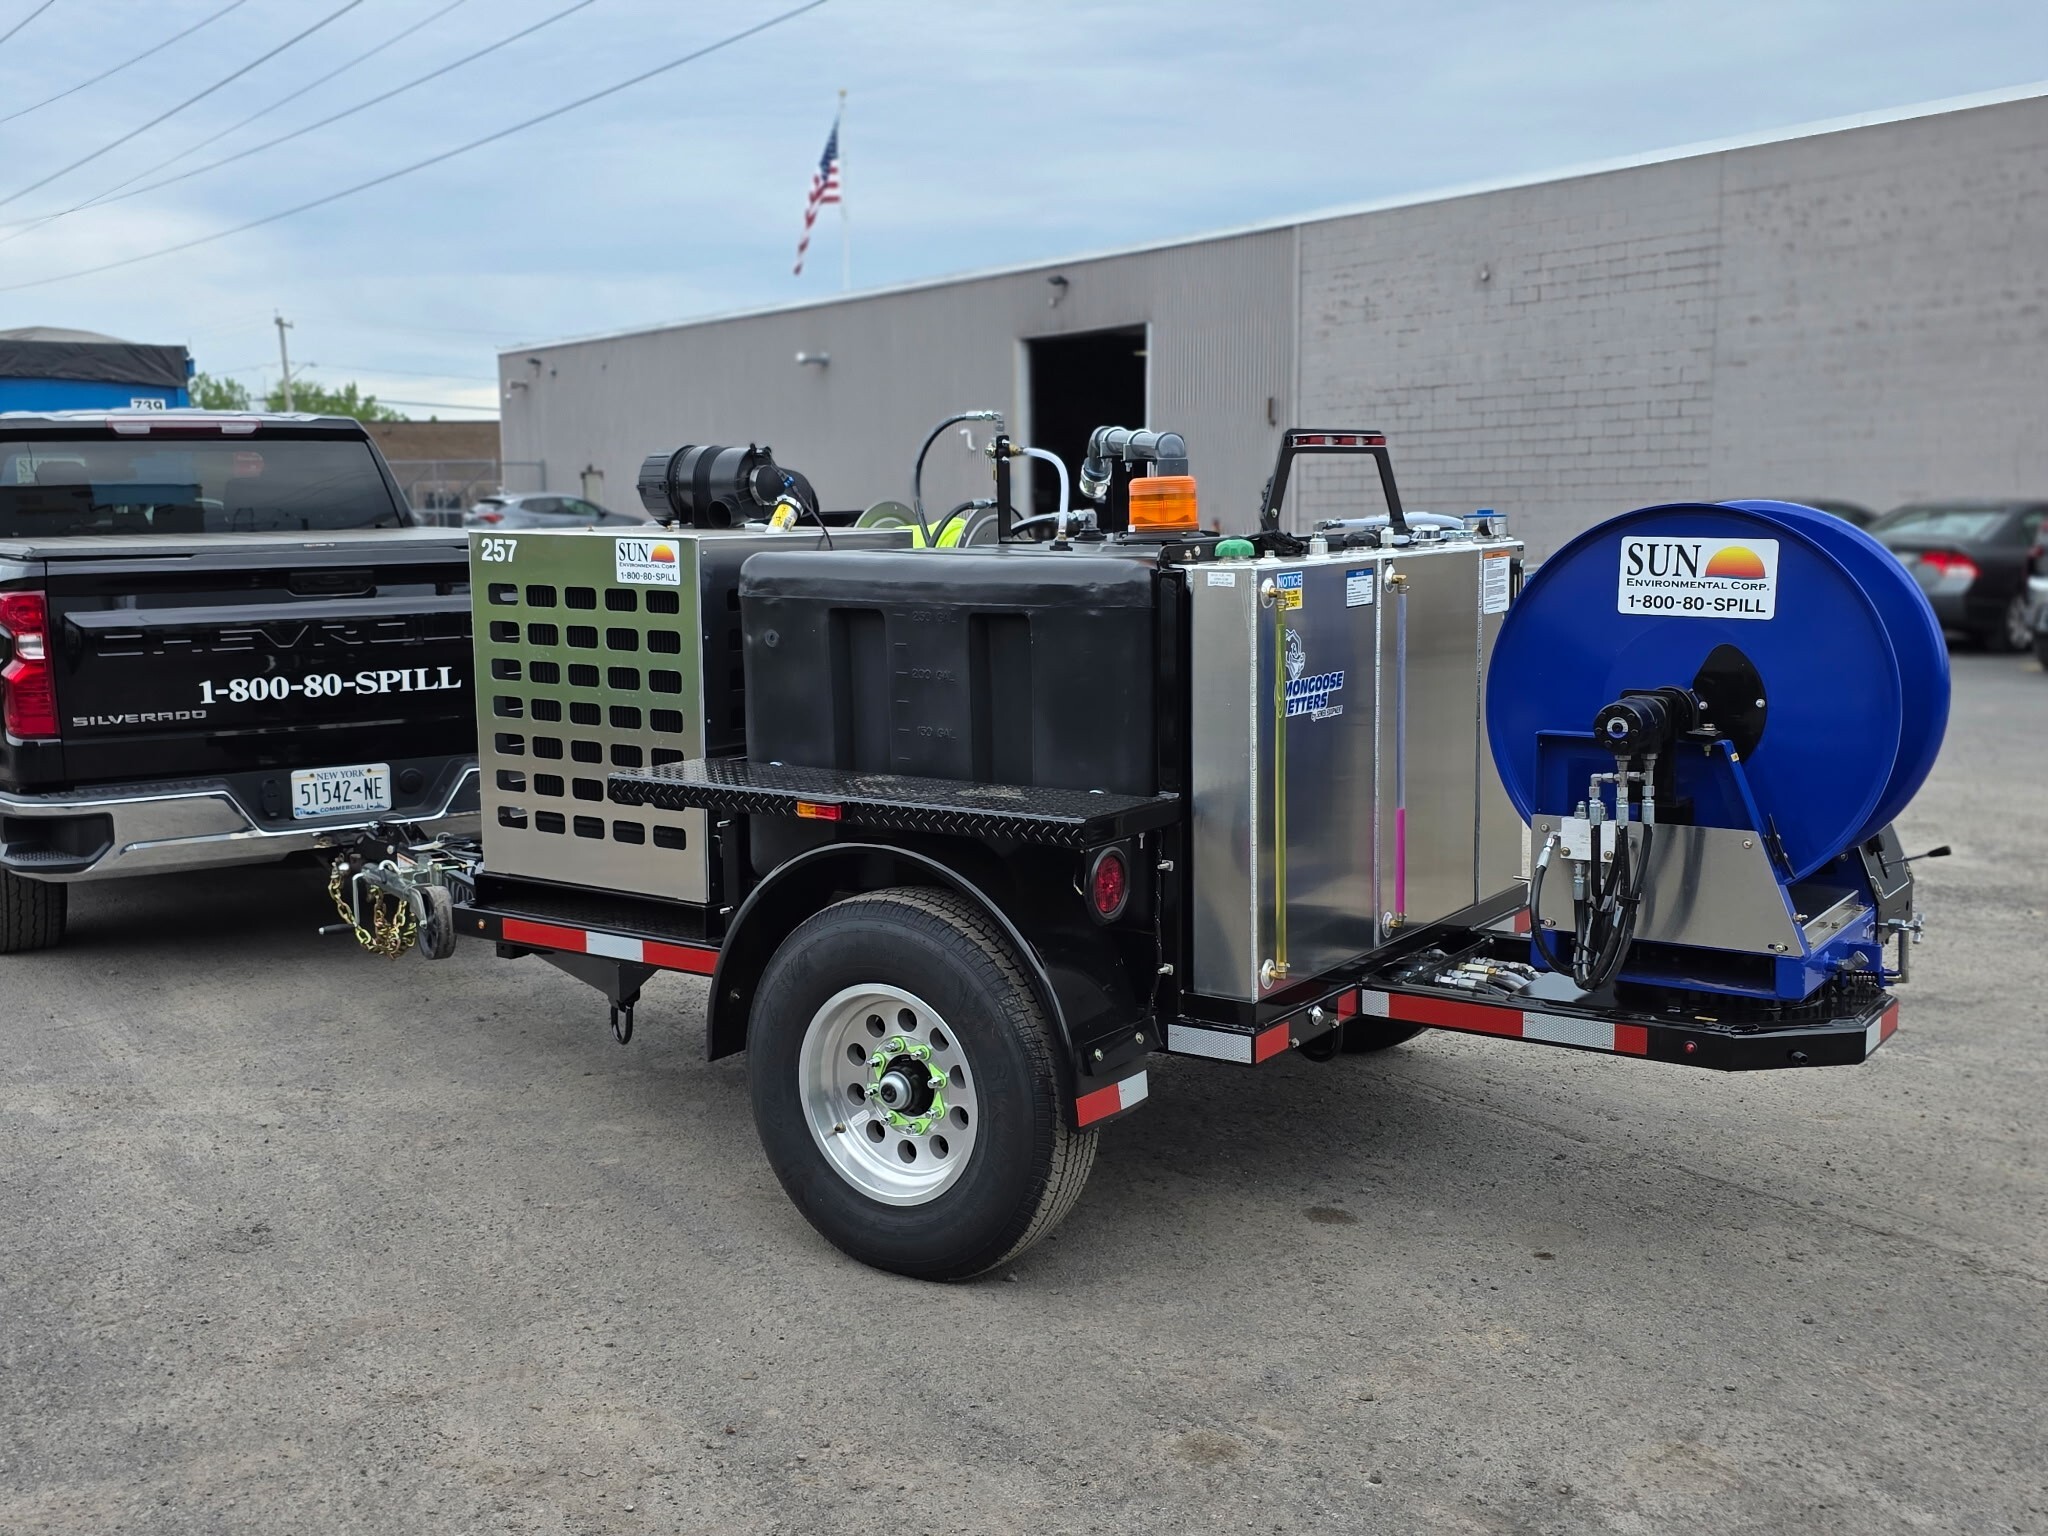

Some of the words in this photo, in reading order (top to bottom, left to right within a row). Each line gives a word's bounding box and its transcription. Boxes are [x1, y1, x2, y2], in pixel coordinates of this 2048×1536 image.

[481, 538, 517, 562] 257
[619, 542, 649, 562] SUN
[619, 561, 661, 569] ENVIRONMENTAL
[1627, 543, 1701, 578] SUN
[620, 571, 677, 582] 1-800-80-SPILL
[1278, 574, 1302, 588] NOTICE
[1626, 578, 1728, 590] ENVIRONMENTAL
[1731, 581, 1770, 592] CORP.
[1628, 594, 1766, 613] 1-800-80-SPILL
[97, 622, 472, 657] CHEVROL
[199, 666, 461, 705] 1-800-80-SPILL
[1285, 672, 1343, 697] MONGOOSE
[1285, 691, 1328, 714] ETTERS
[73, 710, 206, 727] SILVERADO
[316, 771, 338, 780] NEW
[340, 769, 365, 779] YORK
[320, 804, 364, 813] COMMERCIAL
